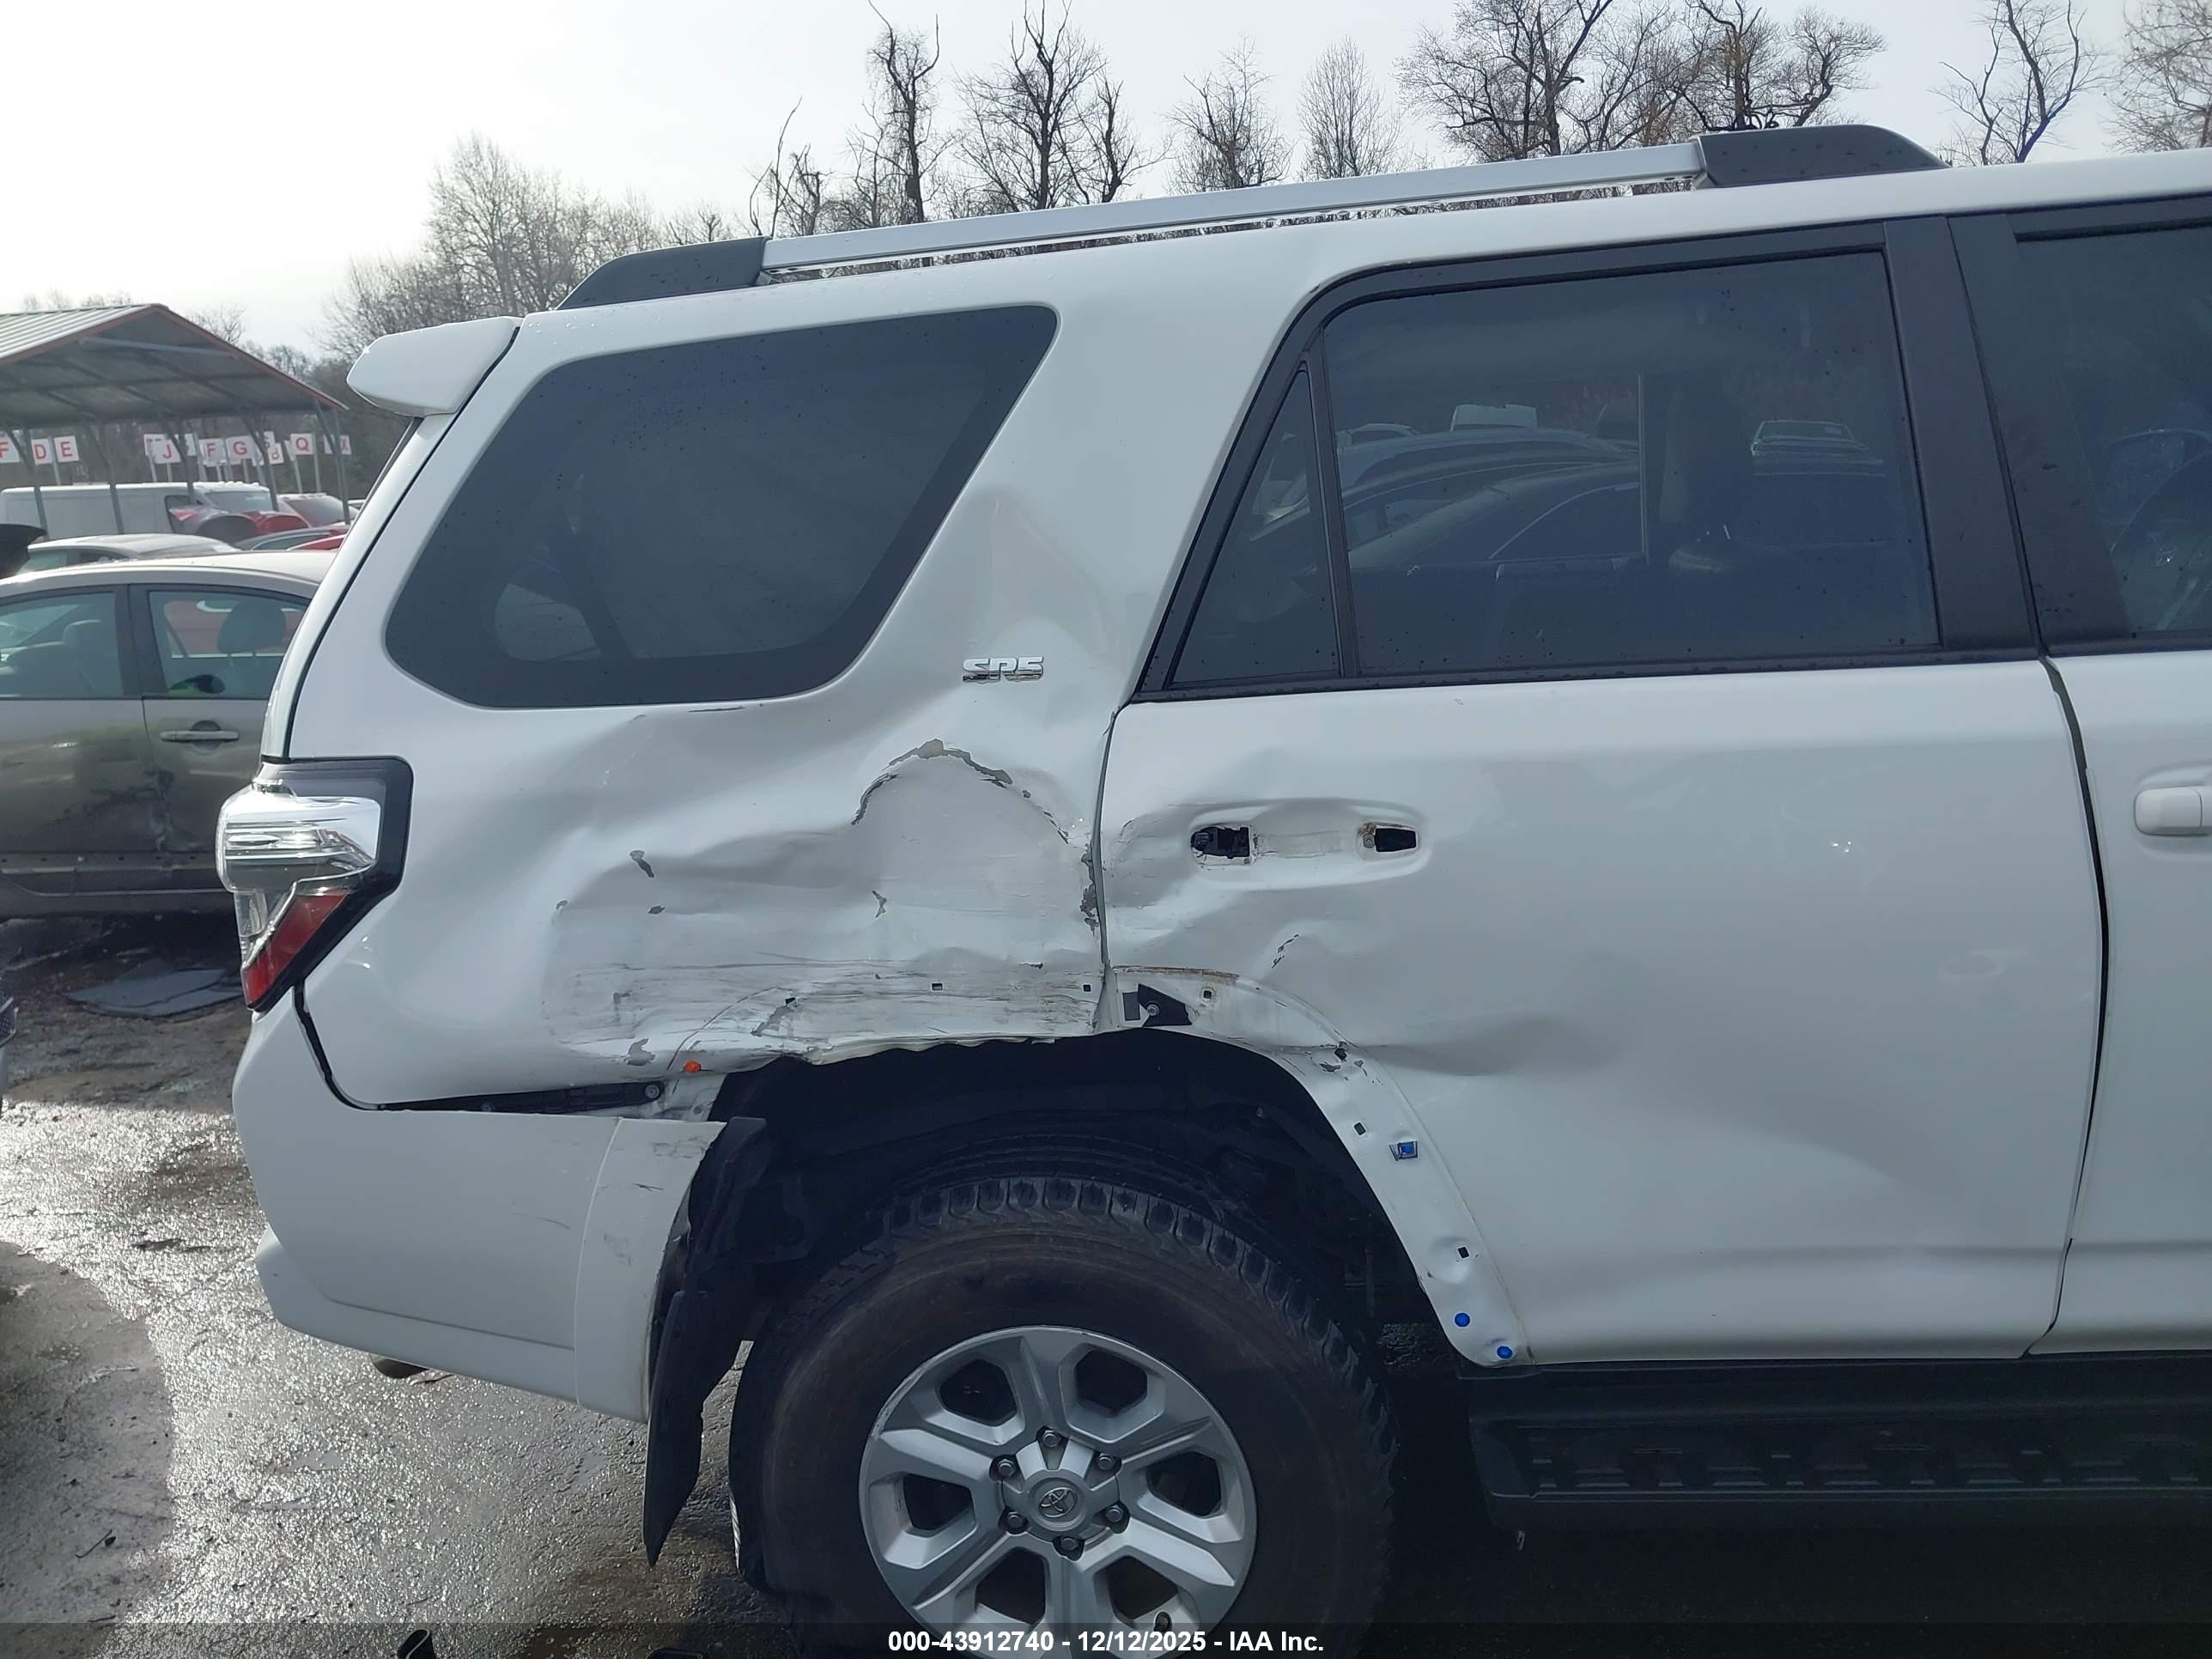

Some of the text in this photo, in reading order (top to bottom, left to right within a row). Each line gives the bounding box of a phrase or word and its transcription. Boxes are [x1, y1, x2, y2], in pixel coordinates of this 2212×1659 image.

[34, 444, 46, 459] D
[60, 441, 73, 458] E
[163, 445, 173, 459] J
[207, 443, 216, 457] F
[233, 441, 248, 455] G
[295, 437, 310, 452] Q
[962, 656, 1044, 684] SR5
